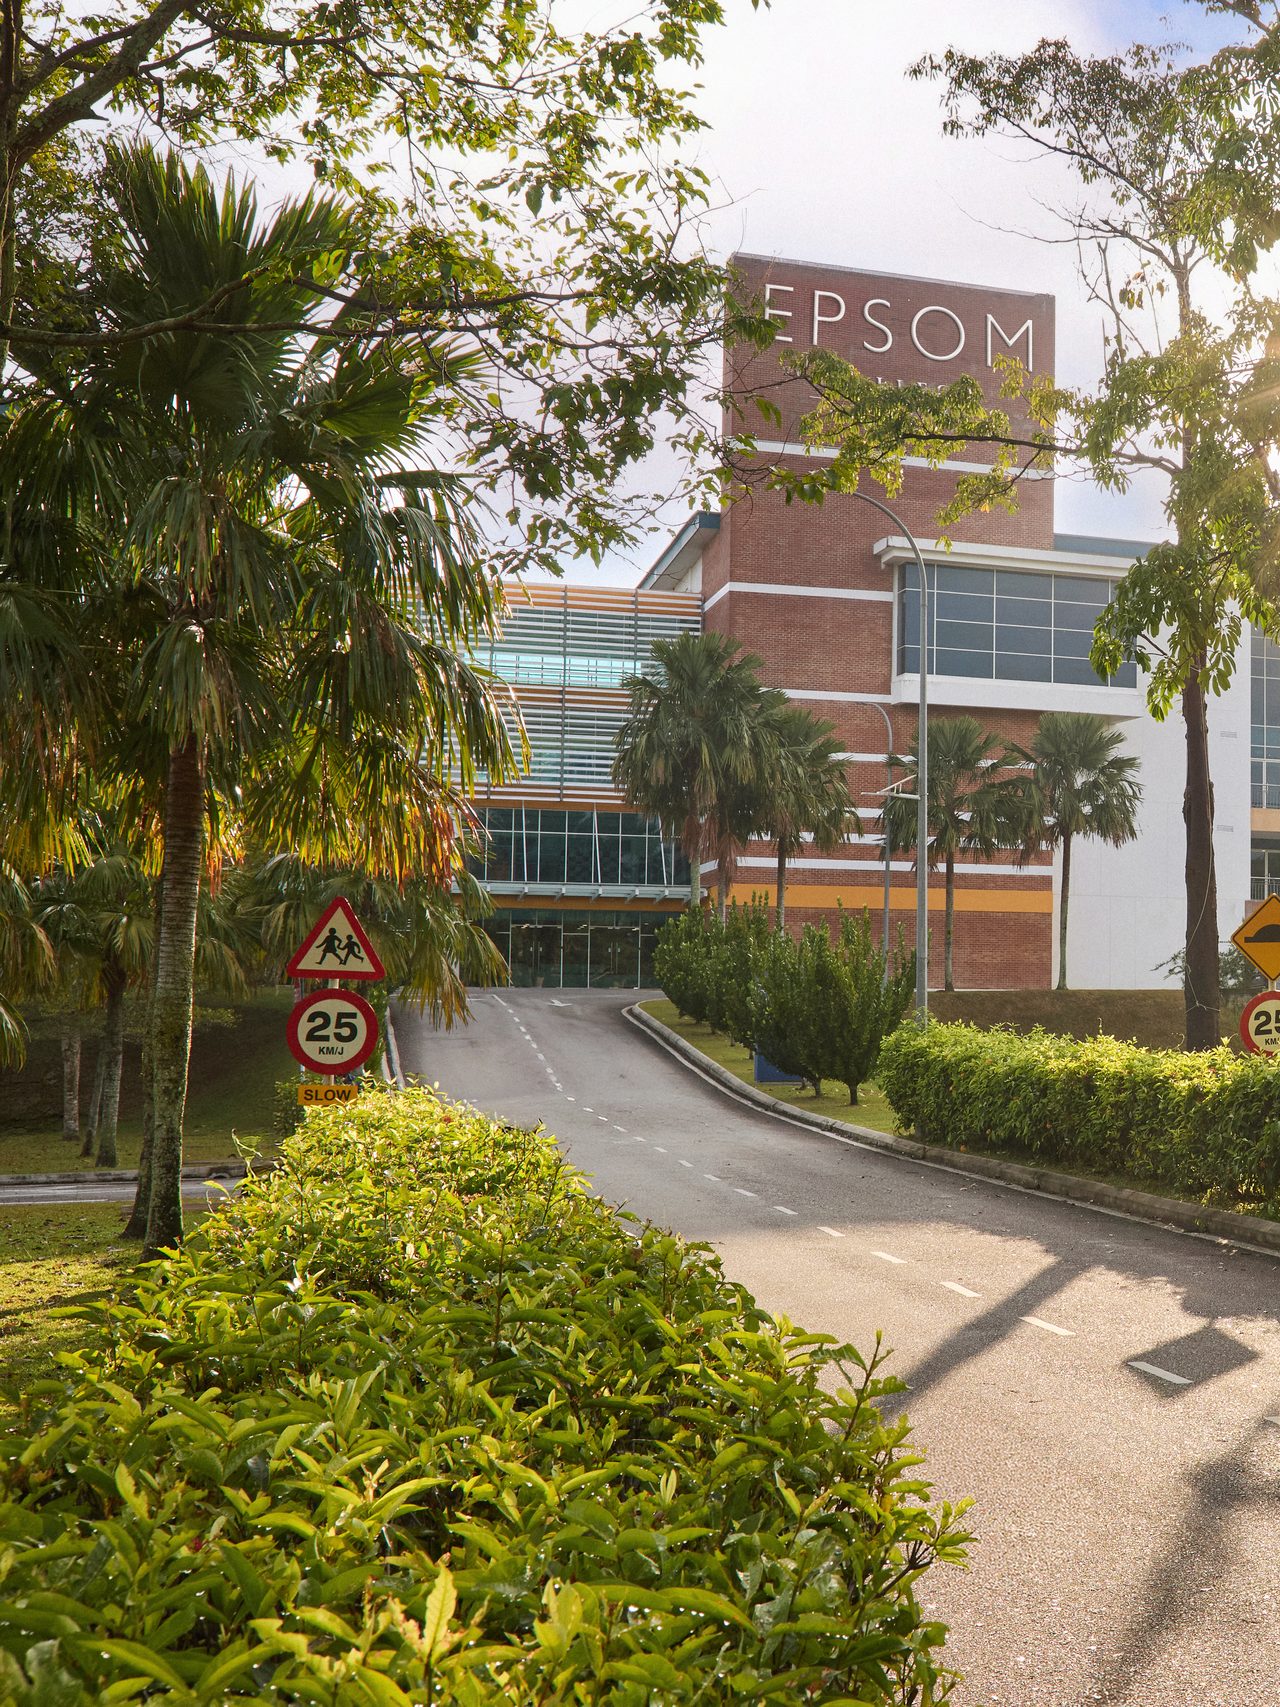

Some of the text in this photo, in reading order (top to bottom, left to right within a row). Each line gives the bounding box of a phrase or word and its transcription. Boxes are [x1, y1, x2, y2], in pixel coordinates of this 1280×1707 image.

[764, 283, 1033, 373] EPSOM
[305, 1010, 359, 1043] 25
[318, 1046, 344, 1056] KM/J
[303, 1089, 352, 1102] SLOW
